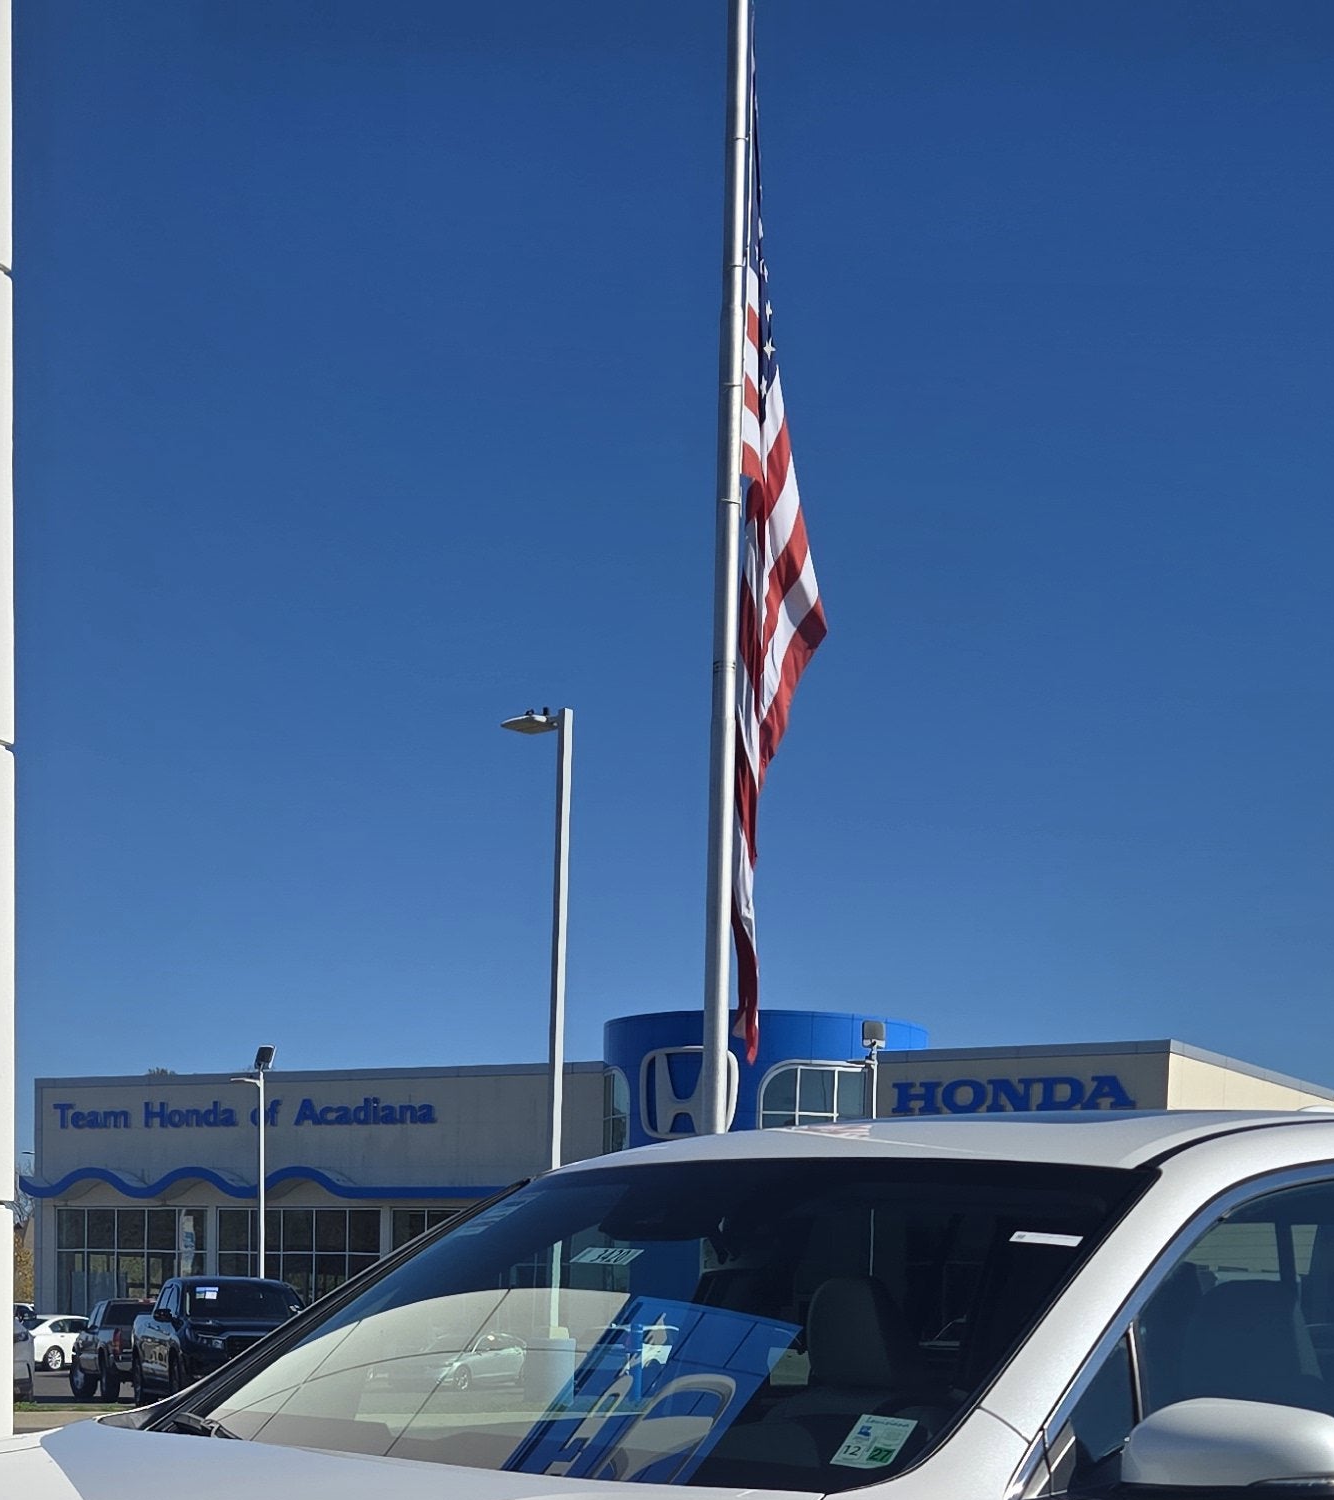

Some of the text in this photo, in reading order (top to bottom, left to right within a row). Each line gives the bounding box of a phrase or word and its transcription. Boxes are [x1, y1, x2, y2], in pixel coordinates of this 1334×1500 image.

[891, 1075, 1137, 1115] HONDA
[53, 1096, 438, 1130] Team Honda of Acadiana
[842, 1444, 862, 1457] 12
[868, 1448, 893, 1463] 27
